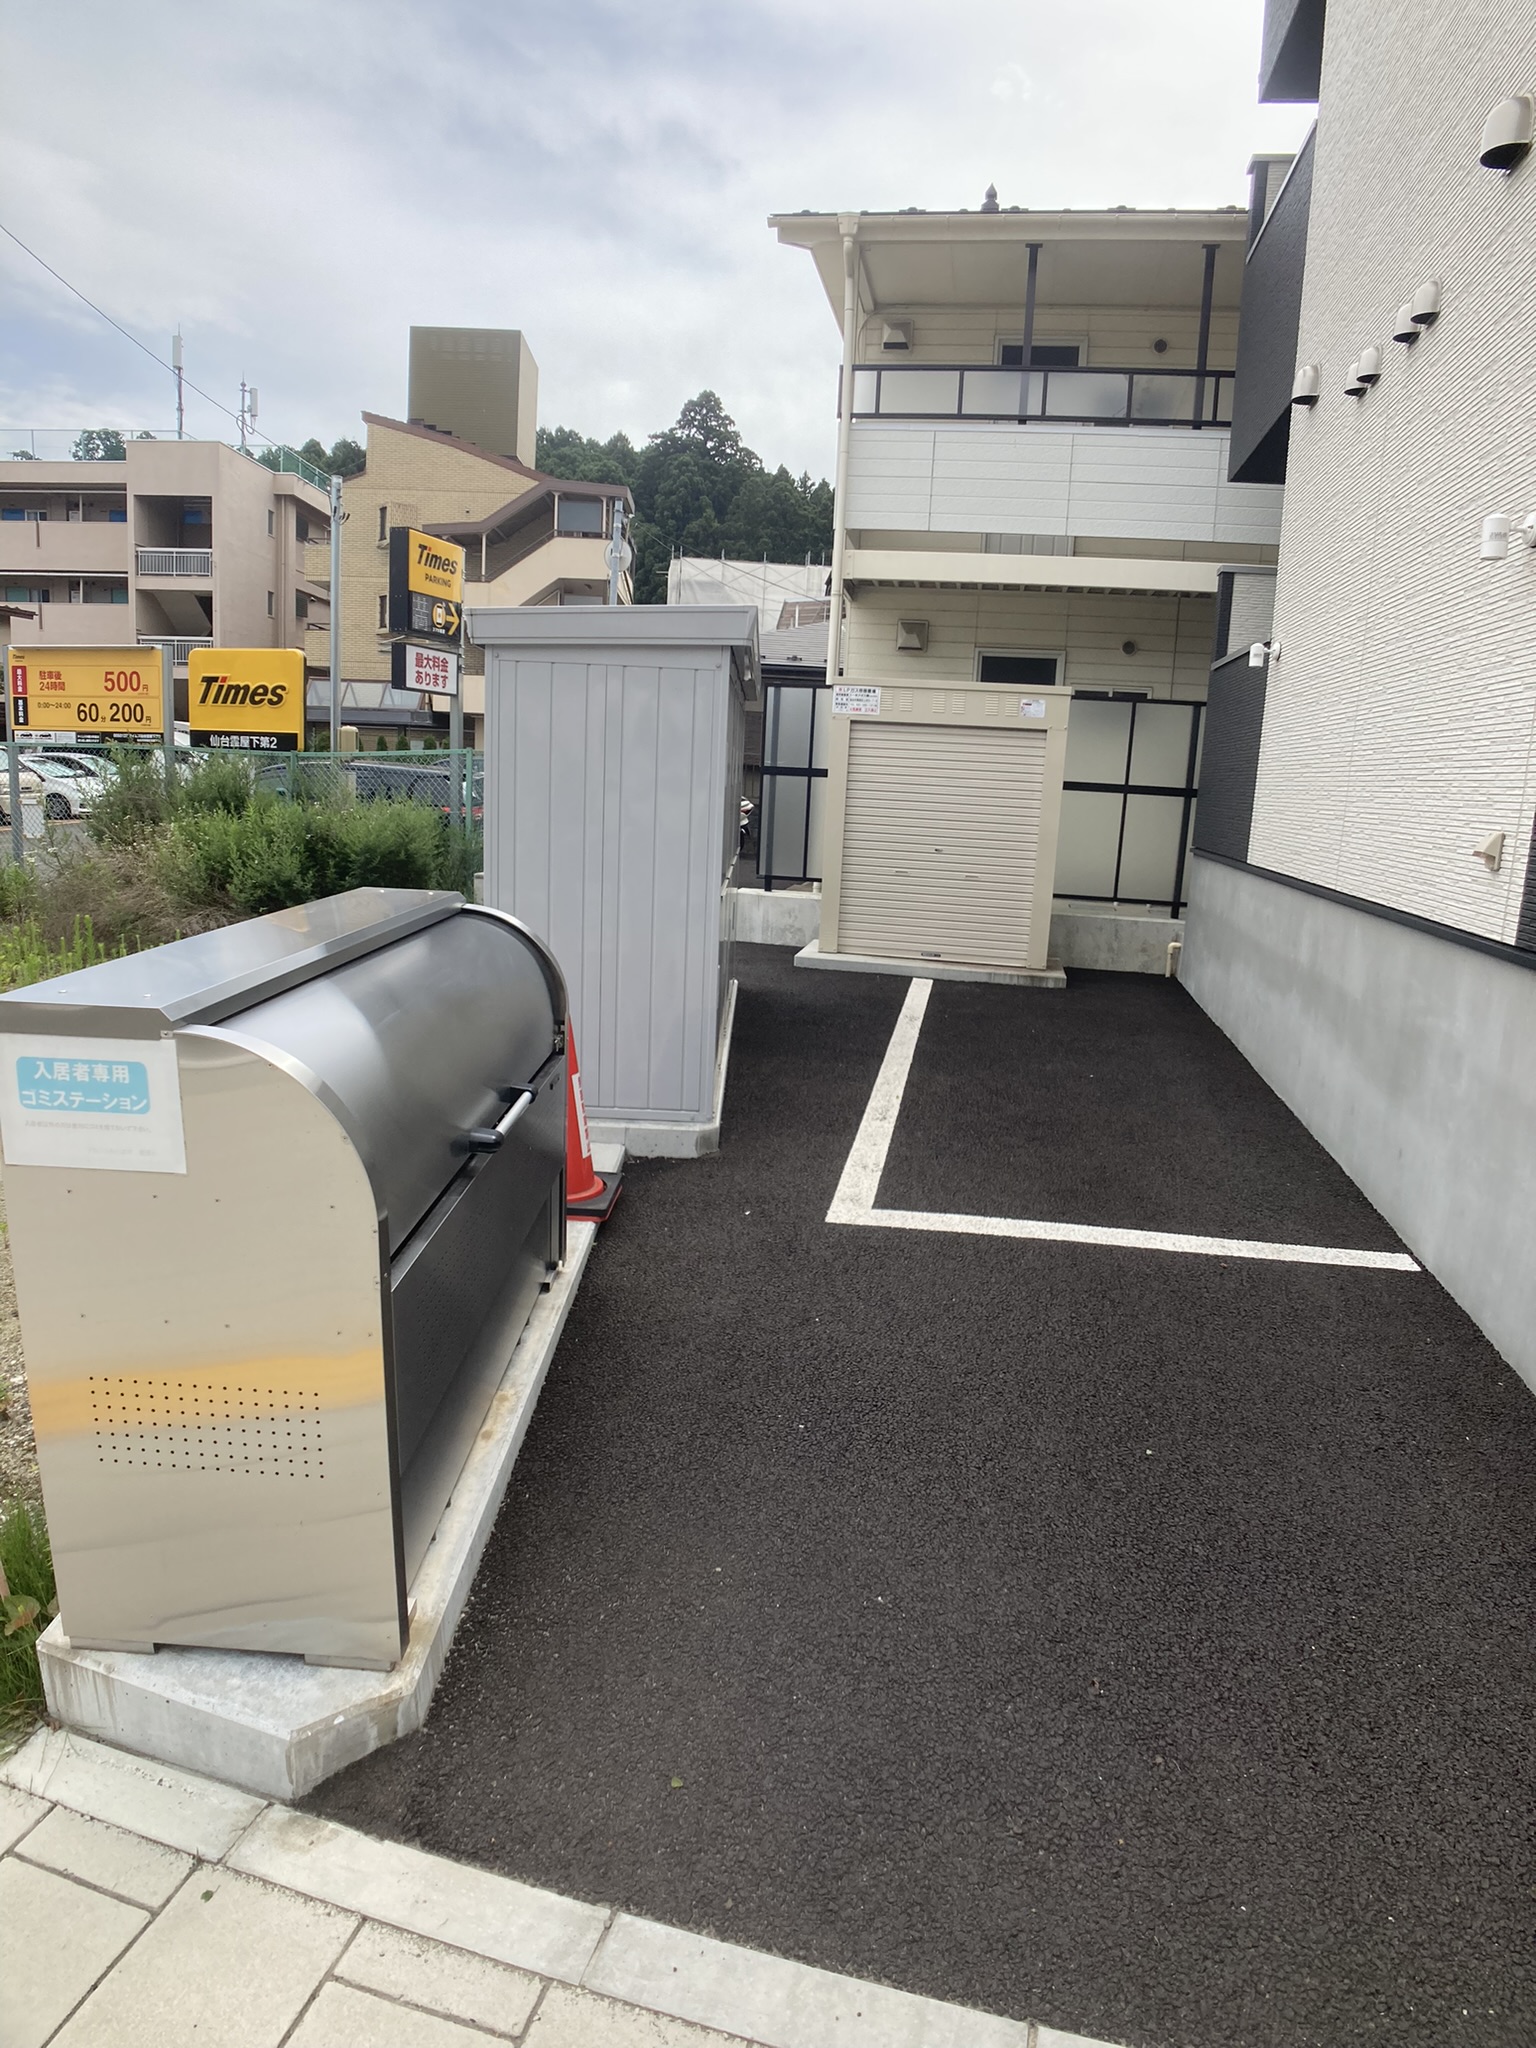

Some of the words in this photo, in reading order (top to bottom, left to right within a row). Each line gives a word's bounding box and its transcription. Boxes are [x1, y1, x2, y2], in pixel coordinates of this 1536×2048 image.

[417, 543, 459, 575] Times
[424, 573, 452, 588] PARKING
[415, 652, 449, 673] 最大料金
[38, 670, 62, 681] 駐車後
[415, 670, 449, 689] あります
[39, 681, 66, 692] 24時間
[198, 675, 288, 706] Times
[33, 1061, 130, 1084] 入居者専用
[21, 1089, 148, 1112] ゴミステーション
